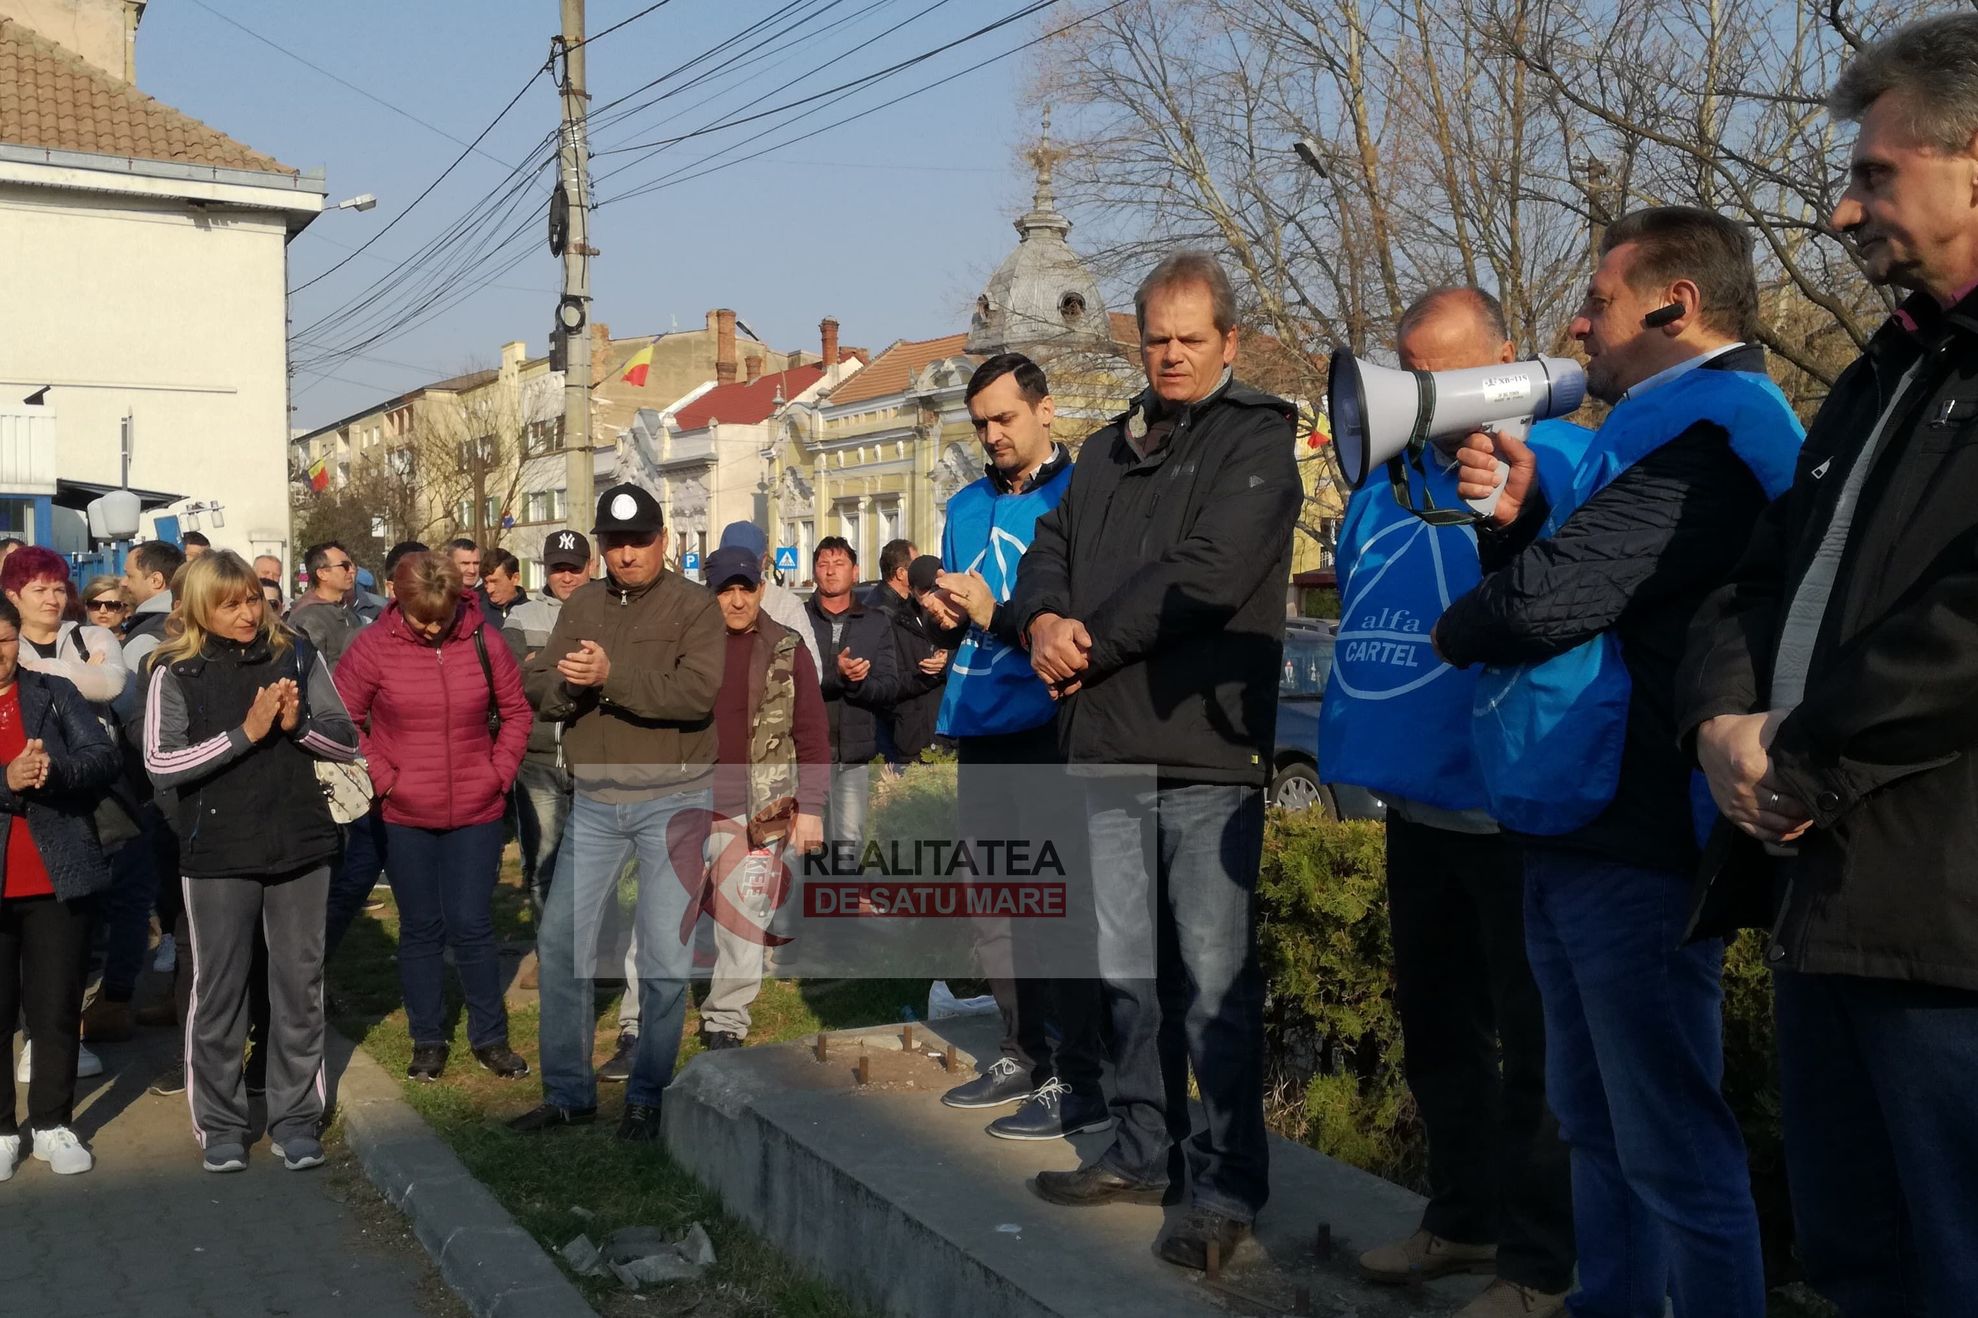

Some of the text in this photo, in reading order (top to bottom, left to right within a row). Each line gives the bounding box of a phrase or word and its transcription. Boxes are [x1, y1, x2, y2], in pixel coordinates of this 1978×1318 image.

[559, 533, 575, 550] NY
[686, 555, 696, 568] P
[1361, 607, 1420, 632] alfa
[1345, 641, 1418, 668] CARTEL
